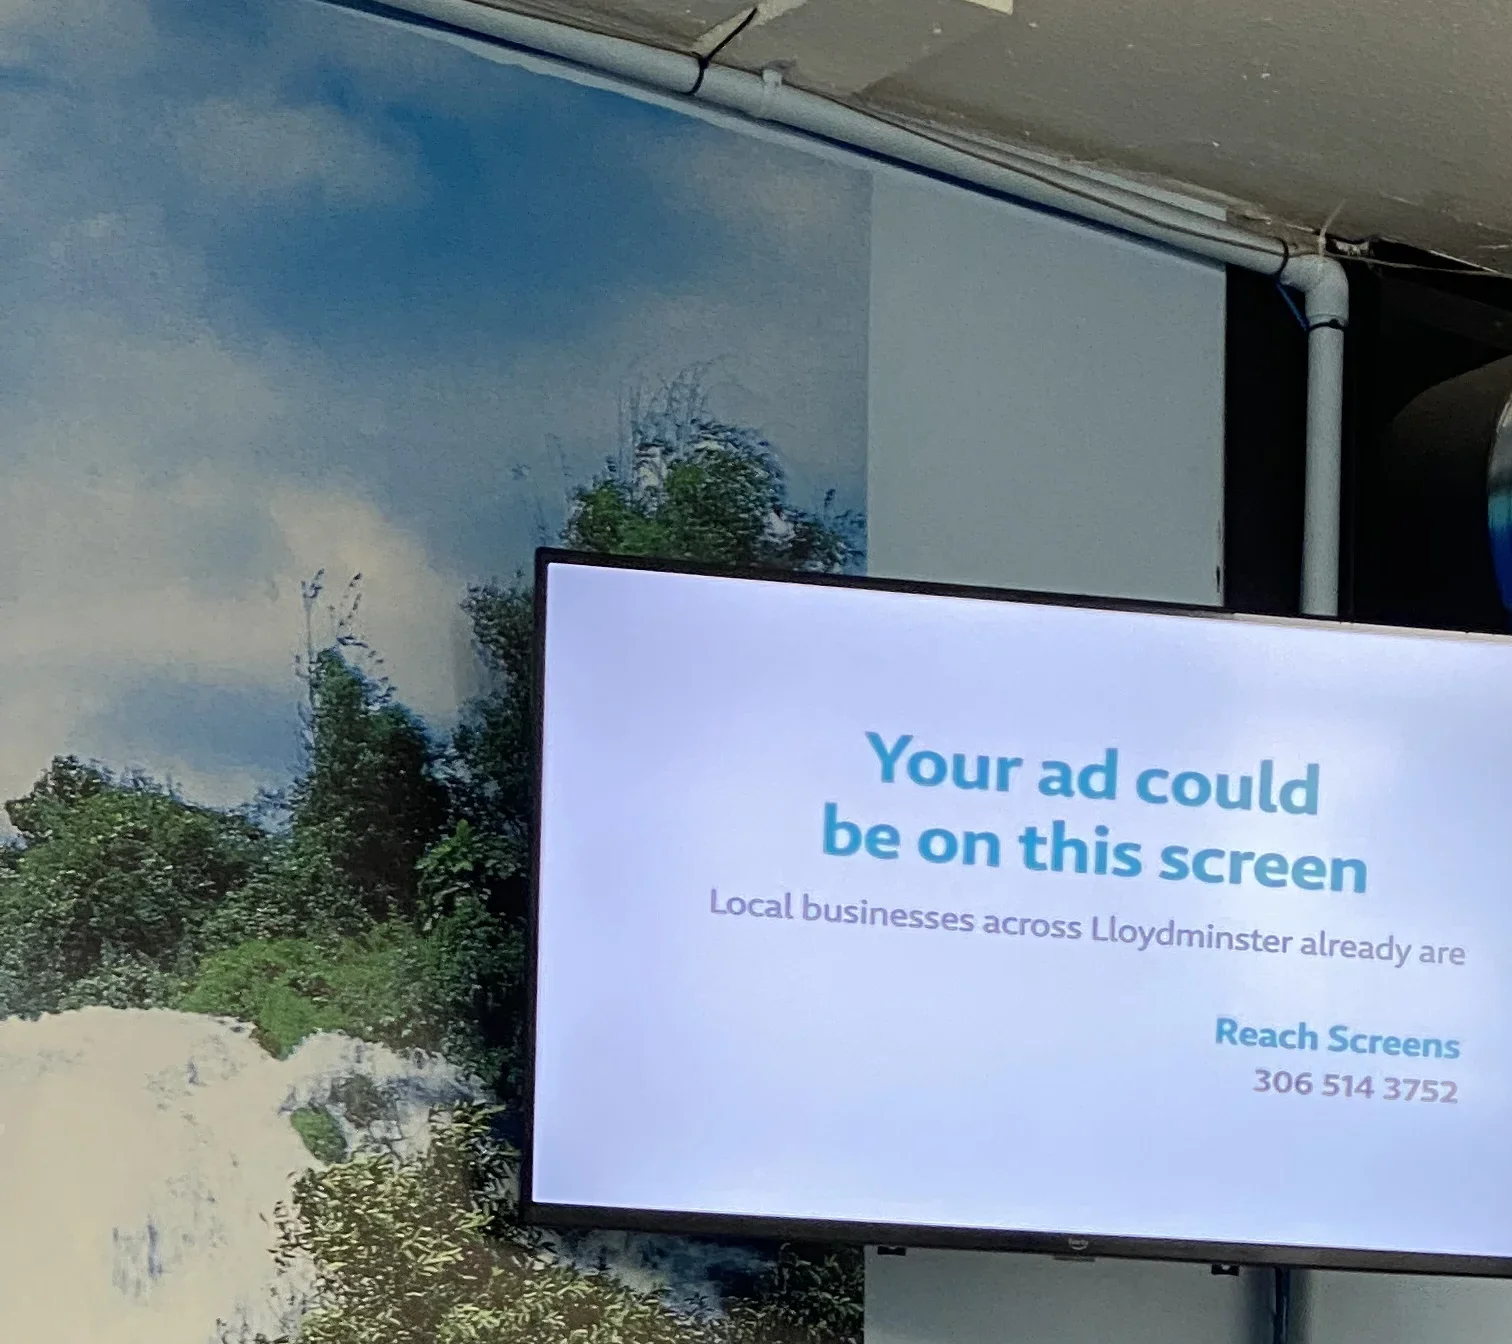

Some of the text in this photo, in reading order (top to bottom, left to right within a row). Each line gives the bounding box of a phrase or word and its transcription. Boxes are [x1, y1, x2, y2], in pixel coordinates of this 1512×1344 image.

[865, 730, 1320, 815] Your ad could
[822, 802, 1368, 893] be on this screen
[710, 888, 1465, 968] Local businesses across Lloydminster already are
[1215, 1017, 1461, 1060] Reach Screens
[1253, 1068, 1459, 1104] 306 514 3752
